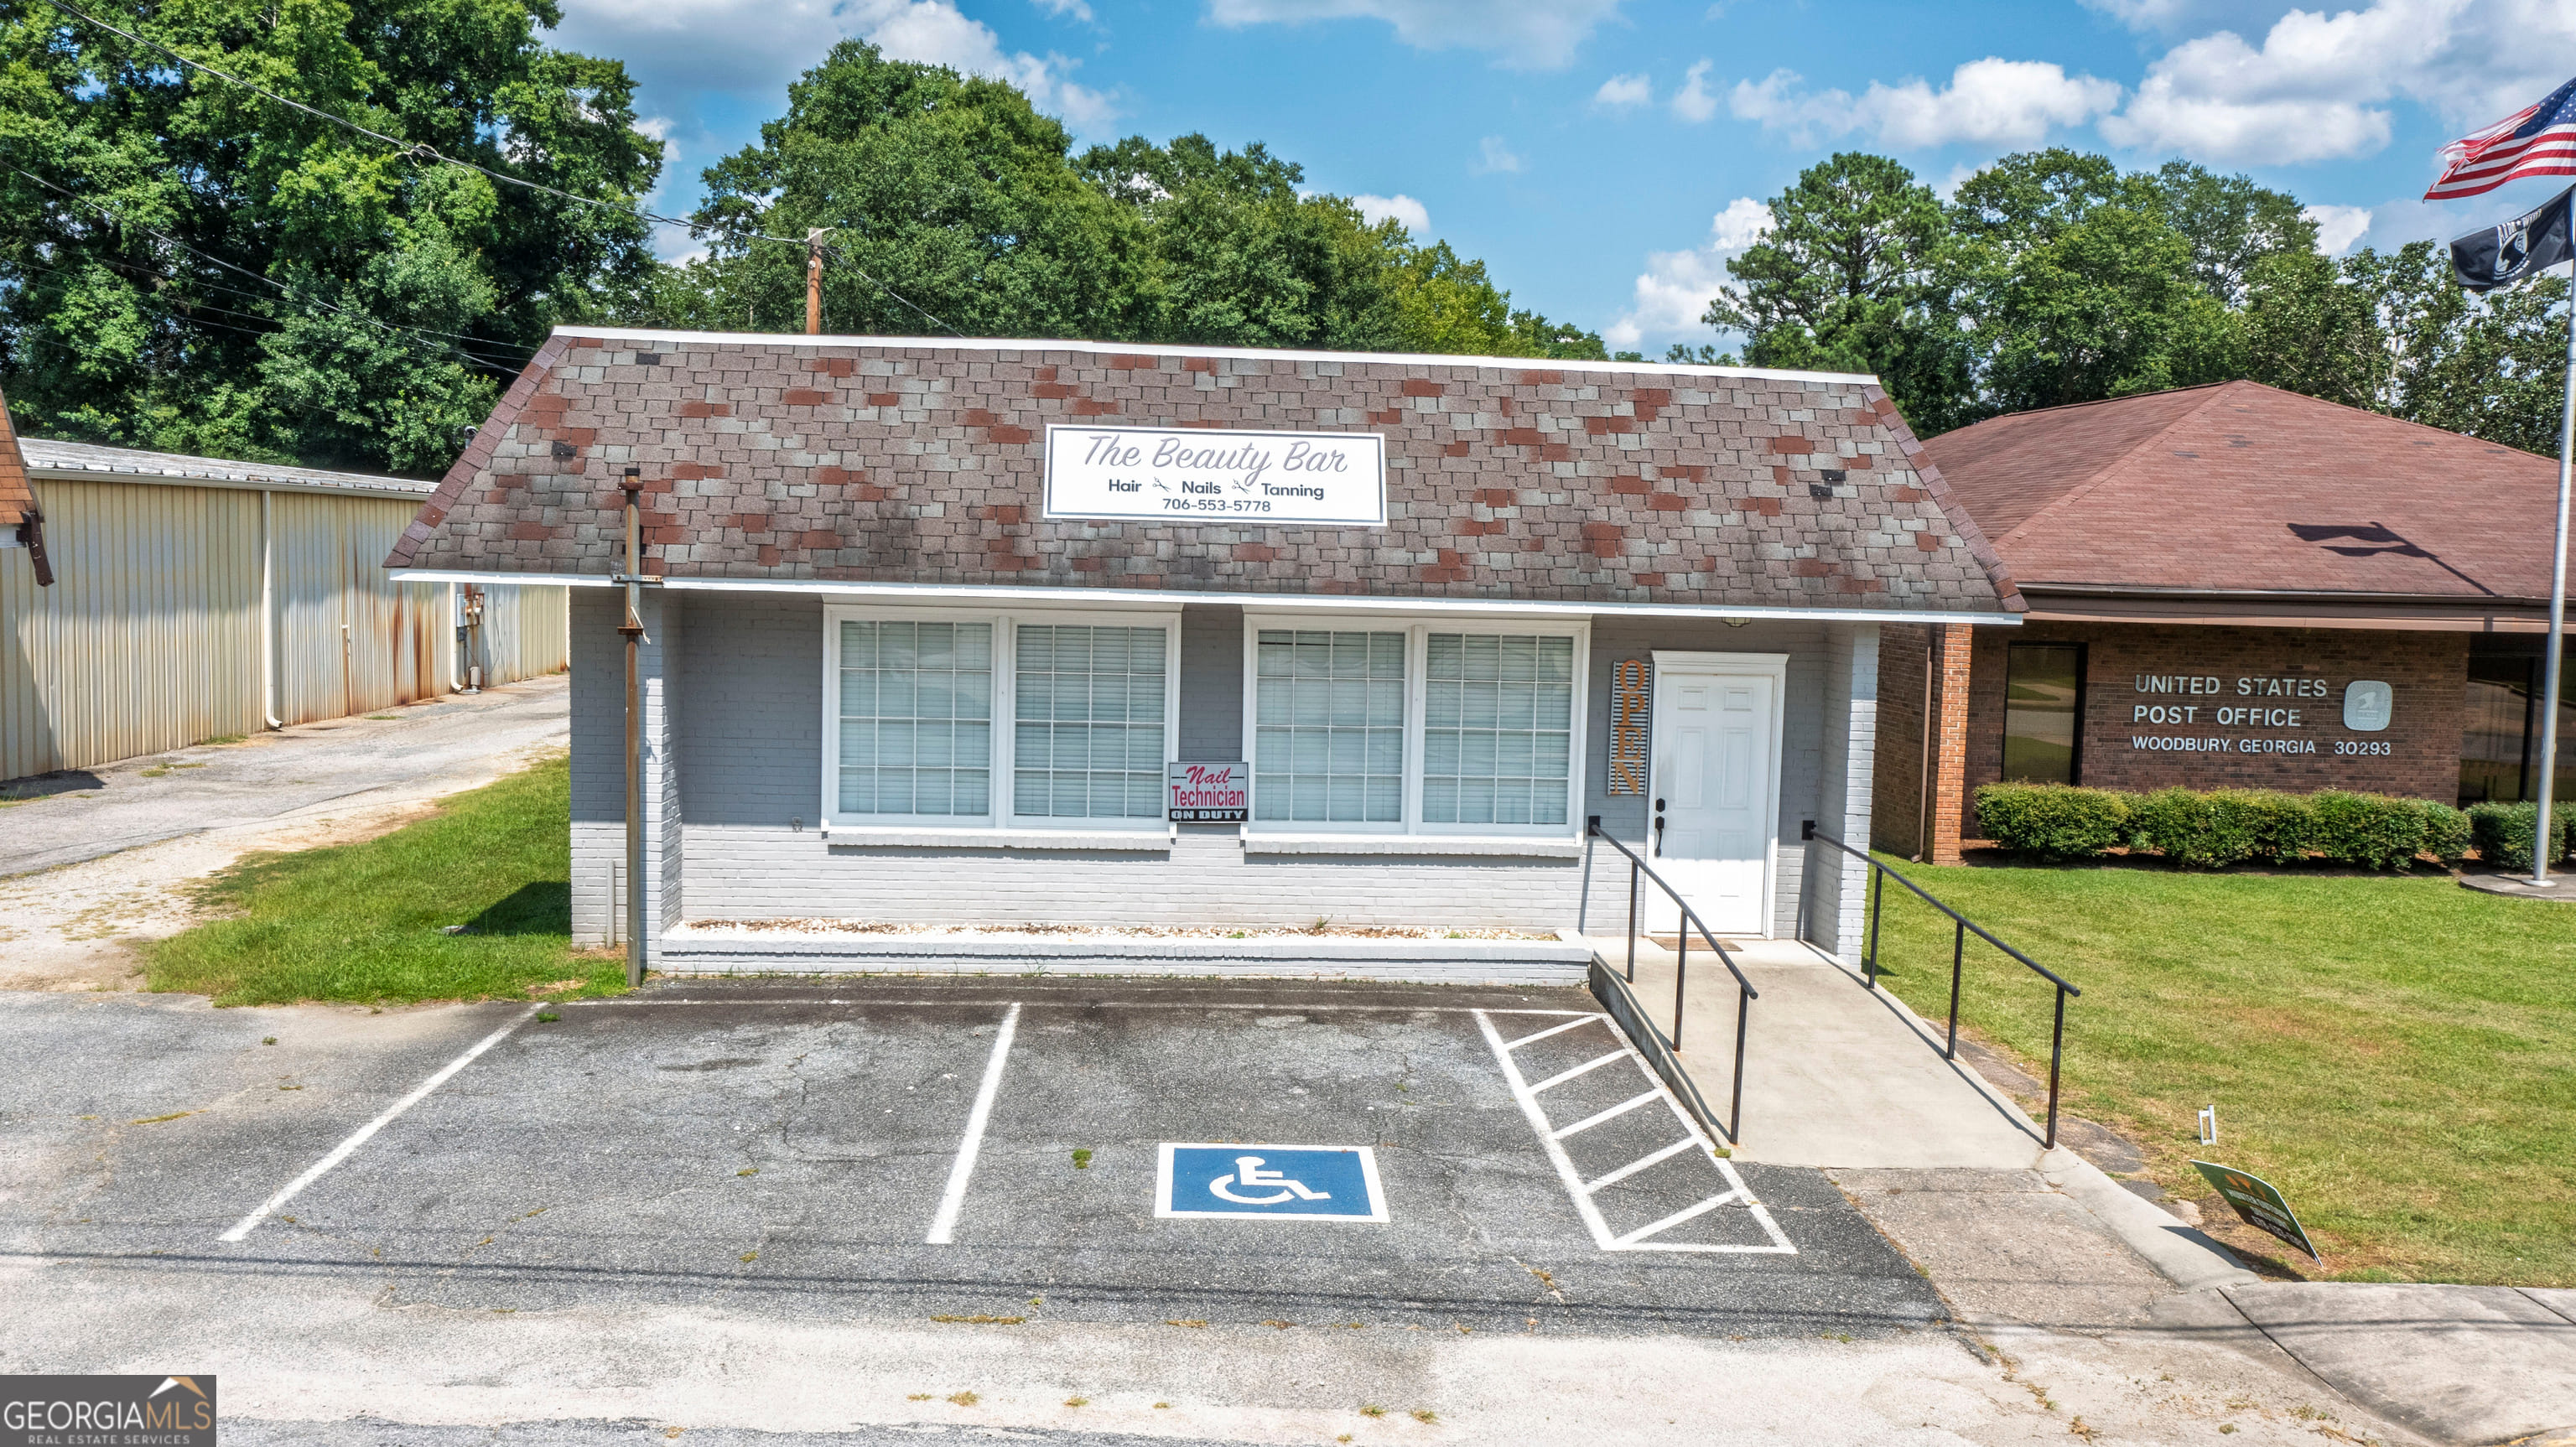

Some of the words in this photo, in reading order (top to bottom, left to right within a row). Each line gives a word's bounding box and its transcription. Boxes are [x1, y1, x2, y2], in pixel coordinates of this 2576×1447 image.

[1085, 433, 1141, 467] The
[1152, 437, 1272, 486] Beauty
[1283, 441, 1348, 472] Bar
[1109, 479, 1142, 492] Hair
[1182, 480, 1221, 495] Nails
[1261, 483, 1324, 500] Tanning
[1162, 498, 1270, 511] 706-553-5778
[2135, 675, 2220, 695] UNITED
[2236, 677, 2327, 698] STATES
[2133, 705, 2198, 724] POST
[2216, 707, 2301, 727] OFFICE
[1610, 660, 1645, 795] OPEN
[2239, 739, 2316, 754] GEORGIA
[2334, 741, 2391, 755] 30293
[1186, 765, 1231, 785] Nail
[1171, 785, 1244, 806] Technician
[1171, 810, 1195, 819] ON
[1198, 810, 1244, 819] DUTY
